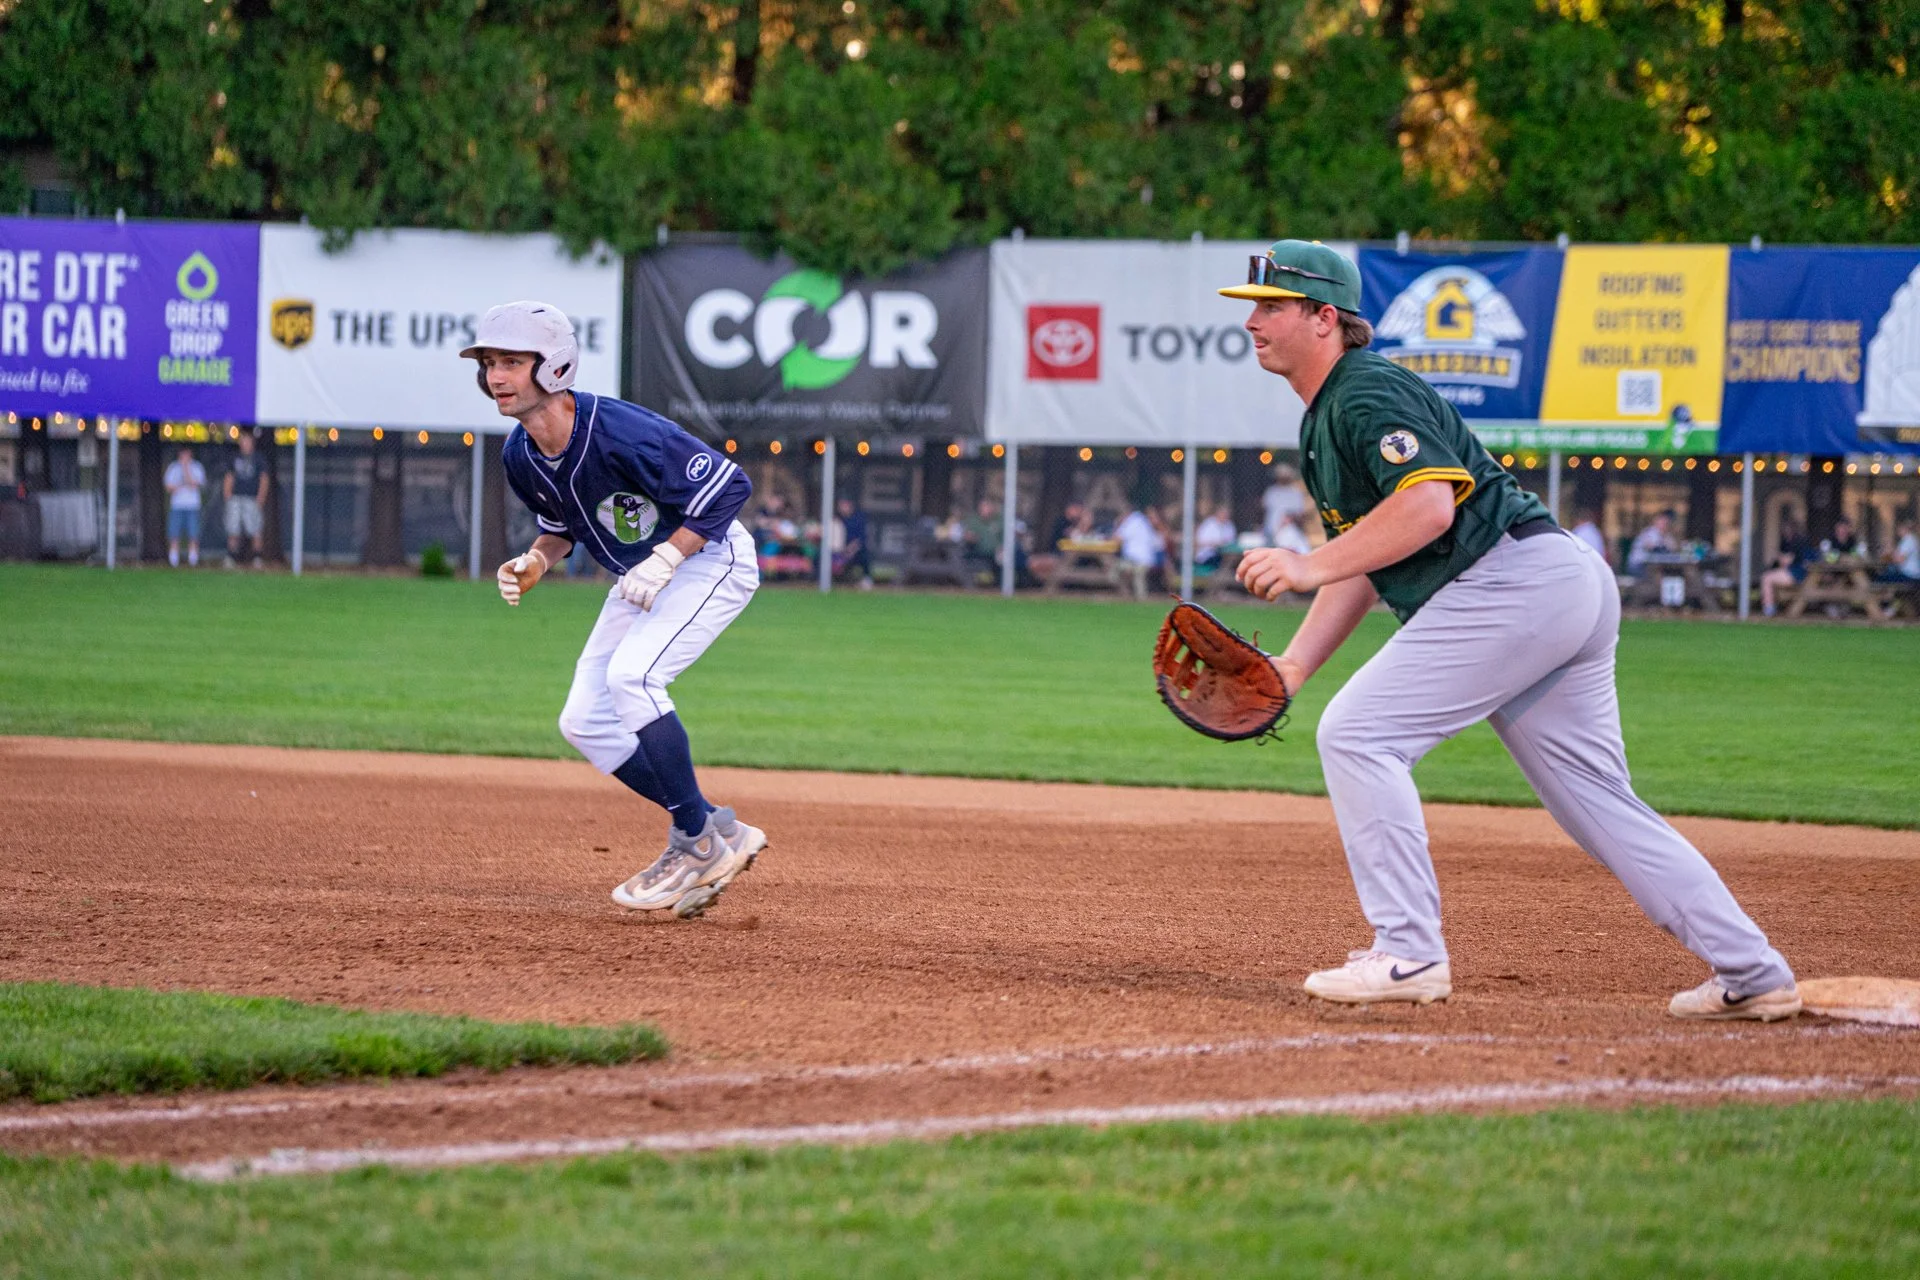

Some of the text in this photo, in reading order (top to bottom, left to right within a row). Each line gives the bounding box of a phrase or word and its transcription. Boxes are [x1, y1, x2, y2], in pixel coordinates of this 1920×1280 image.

[41, 302, 127, 359] CAR
[165, 299, 229, 330] GREEN
[331, 310, 478, 349] THE UPS
[684, 270, 940, 388] COR
[1593, 308, 1684, 332] GUTTERS
[170, 329, 223, 357] DROP
[1122, 323, 1252, 364] TOYO
[1581, 343, 1698, 367] INSULATION
[158, 355, 231, 386] GARAGE
[1726, 346, 1860, 383] CHAMPIONS
